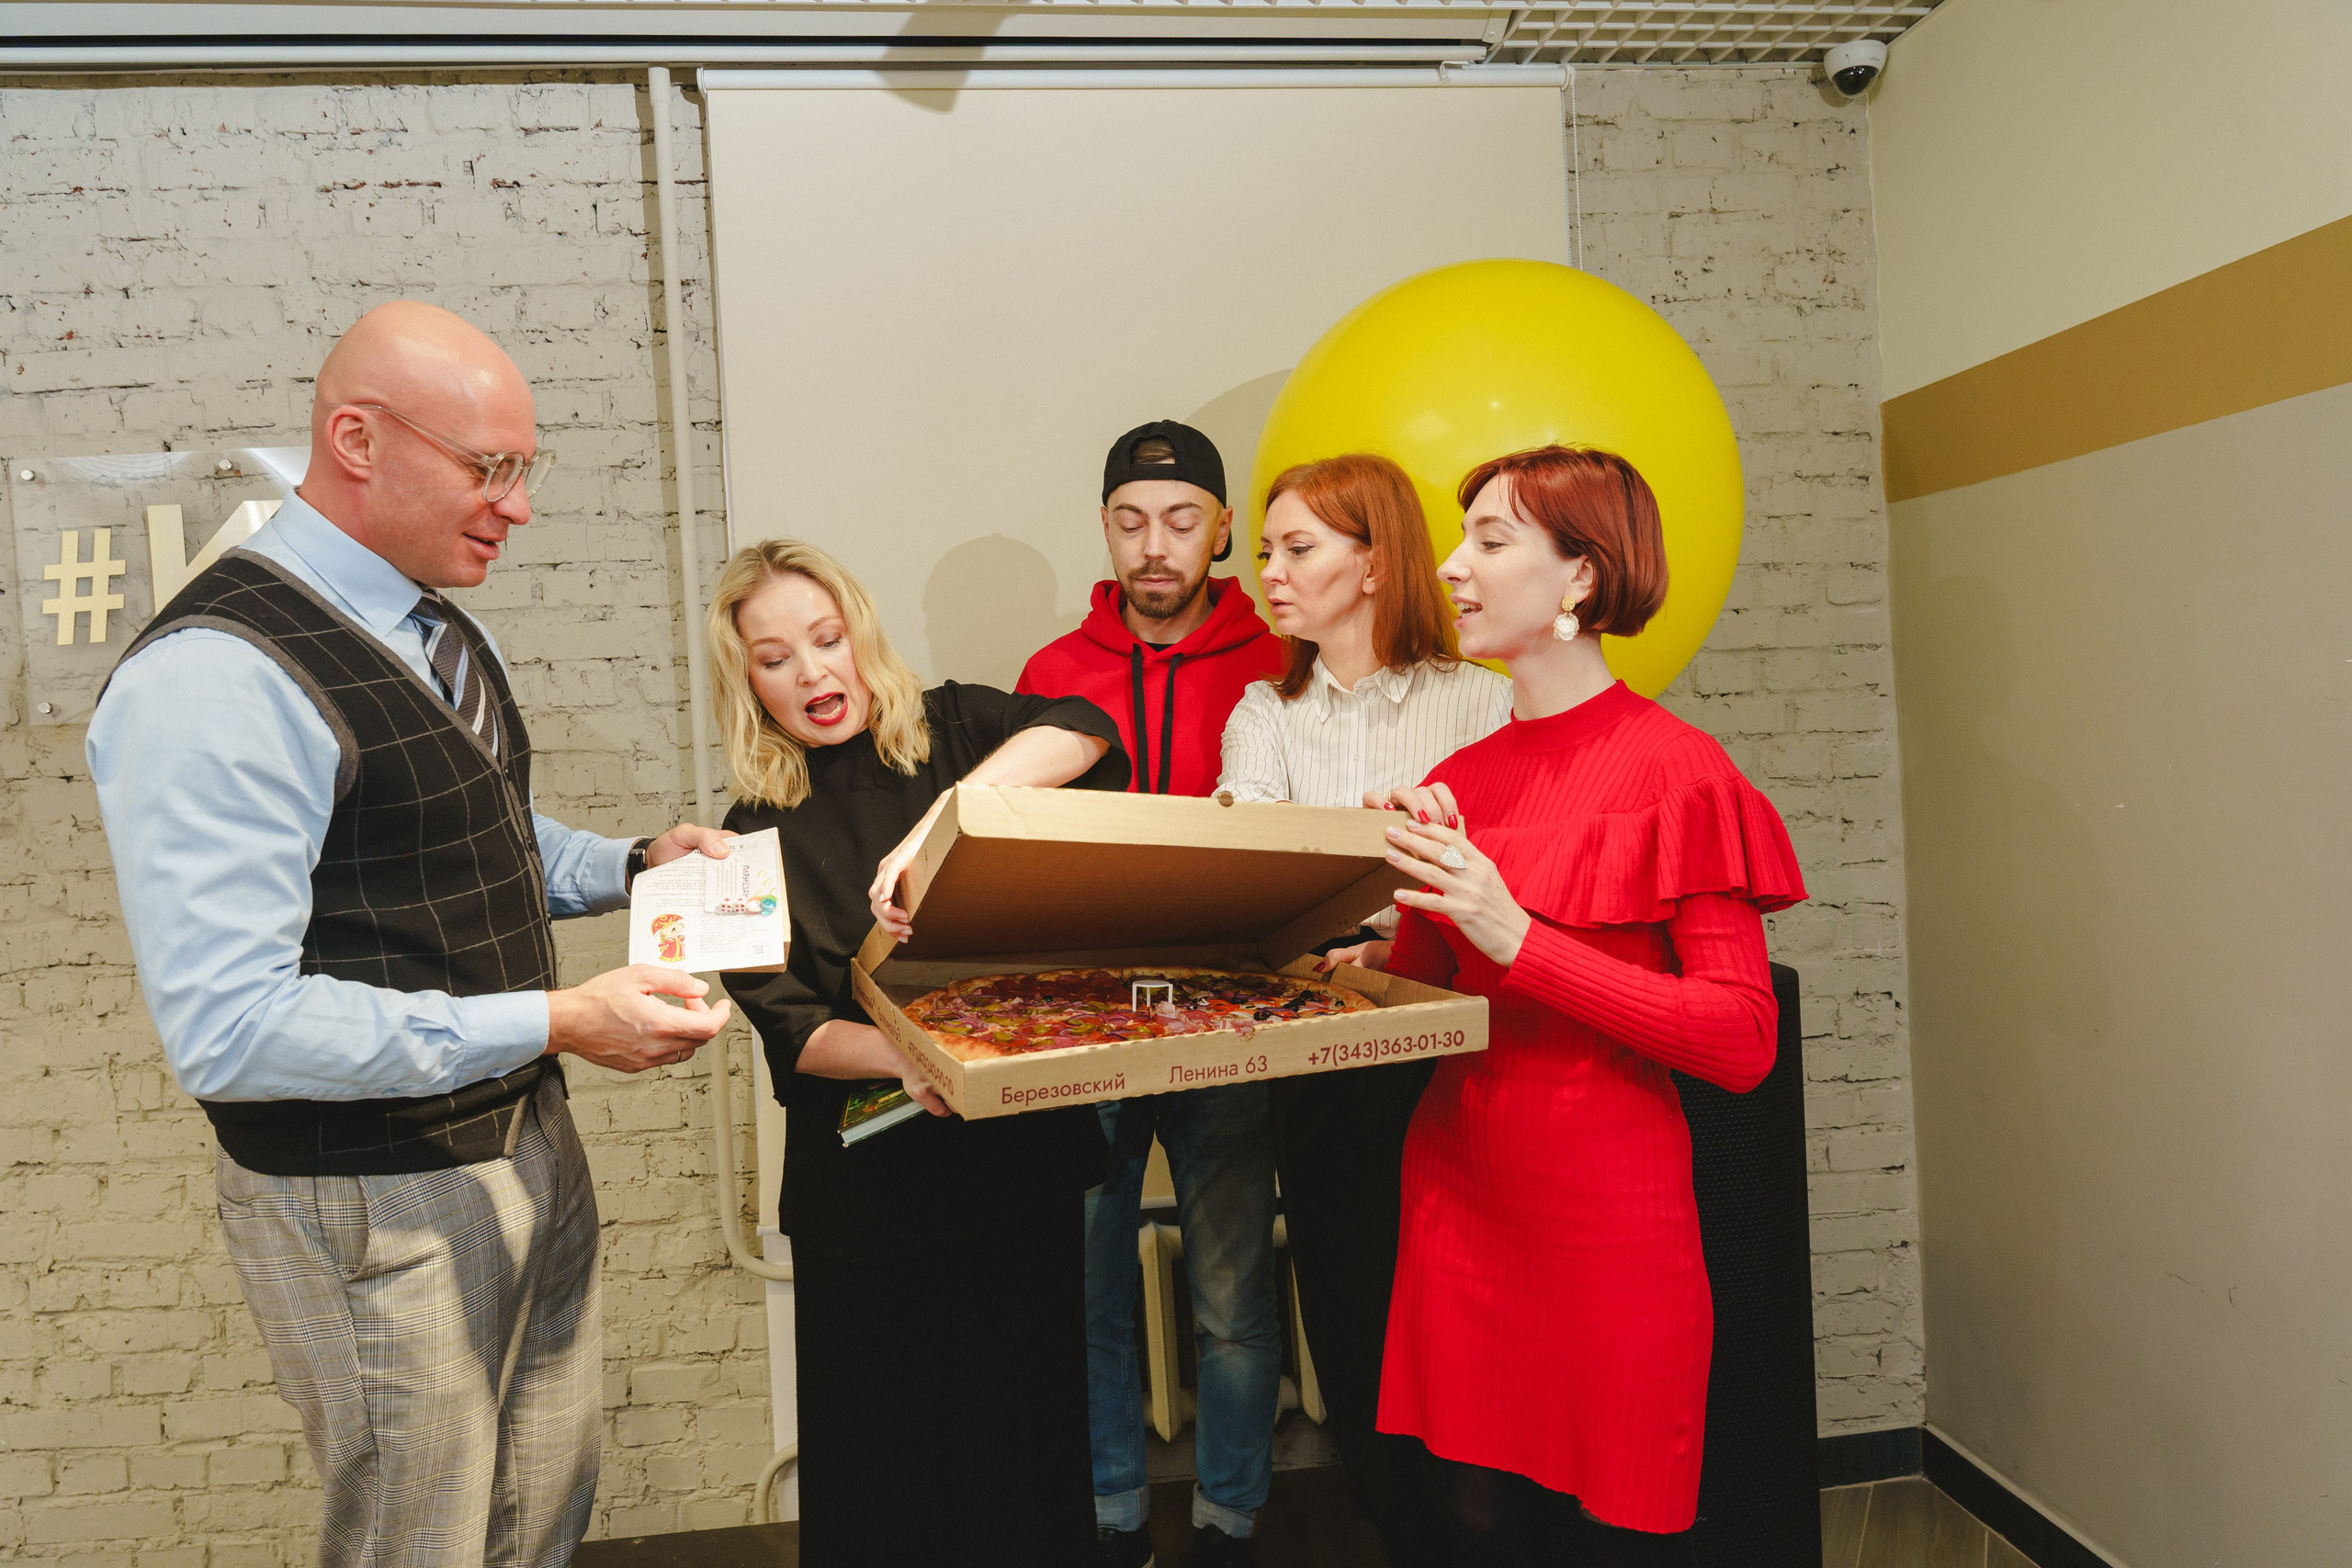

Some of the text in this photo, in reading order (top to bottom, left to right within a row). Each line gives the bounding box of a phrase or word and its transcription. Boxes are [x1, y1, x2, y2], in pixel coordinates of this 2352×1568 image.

[1001, 1030, 1465, 1106] Березовский Ленина 63 +7(343)363-01-30
